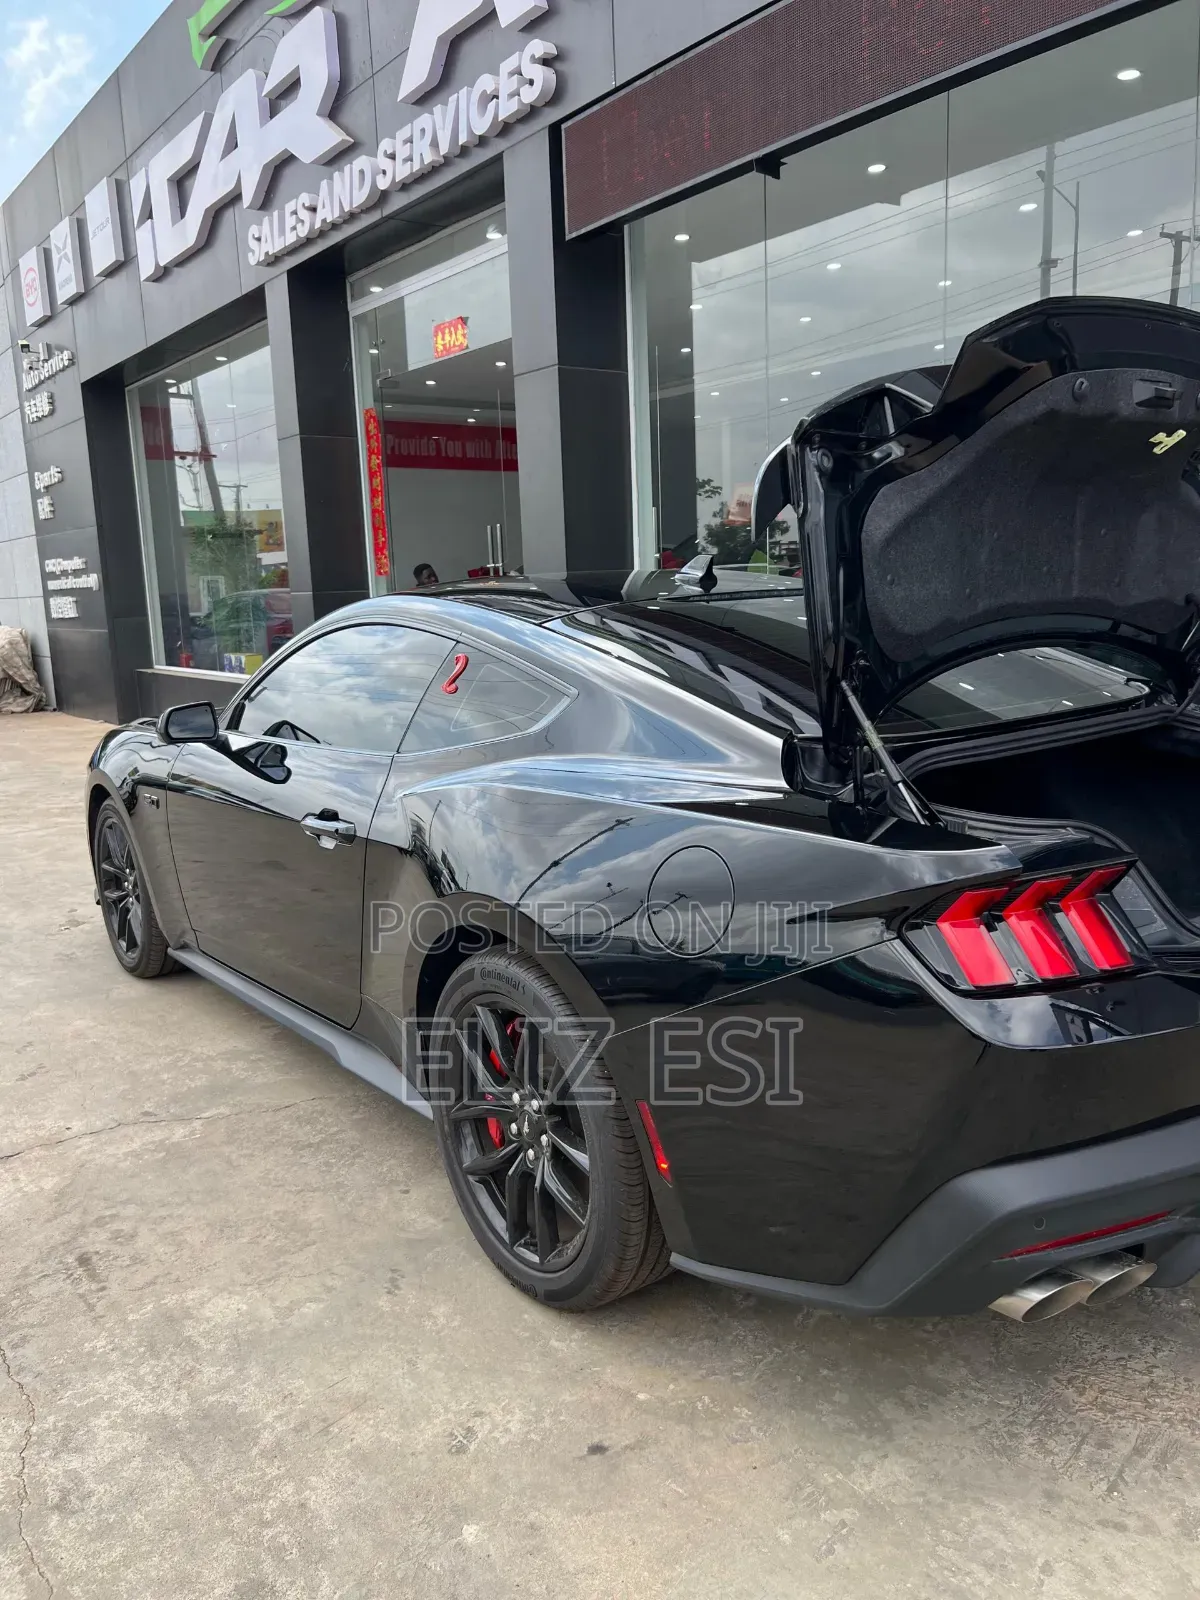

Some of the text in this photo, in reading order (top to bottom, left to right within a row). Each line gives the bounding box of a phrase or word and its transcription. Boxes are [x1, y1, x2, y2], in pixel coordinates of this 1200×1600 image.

[247, 192, 319, 267] SALES
[314, 154, 381, 230] AND
[376, 38, 558, 191] SERVICES
[90, 216, 111, 241] JETOUR
[40, 350, 73, 381] Service
[386, 434, 436, 457] Provide
[440, 437, 462, 458] You
[465, 439, 492, 459] with
[480, 967, 521, 991] Continental
